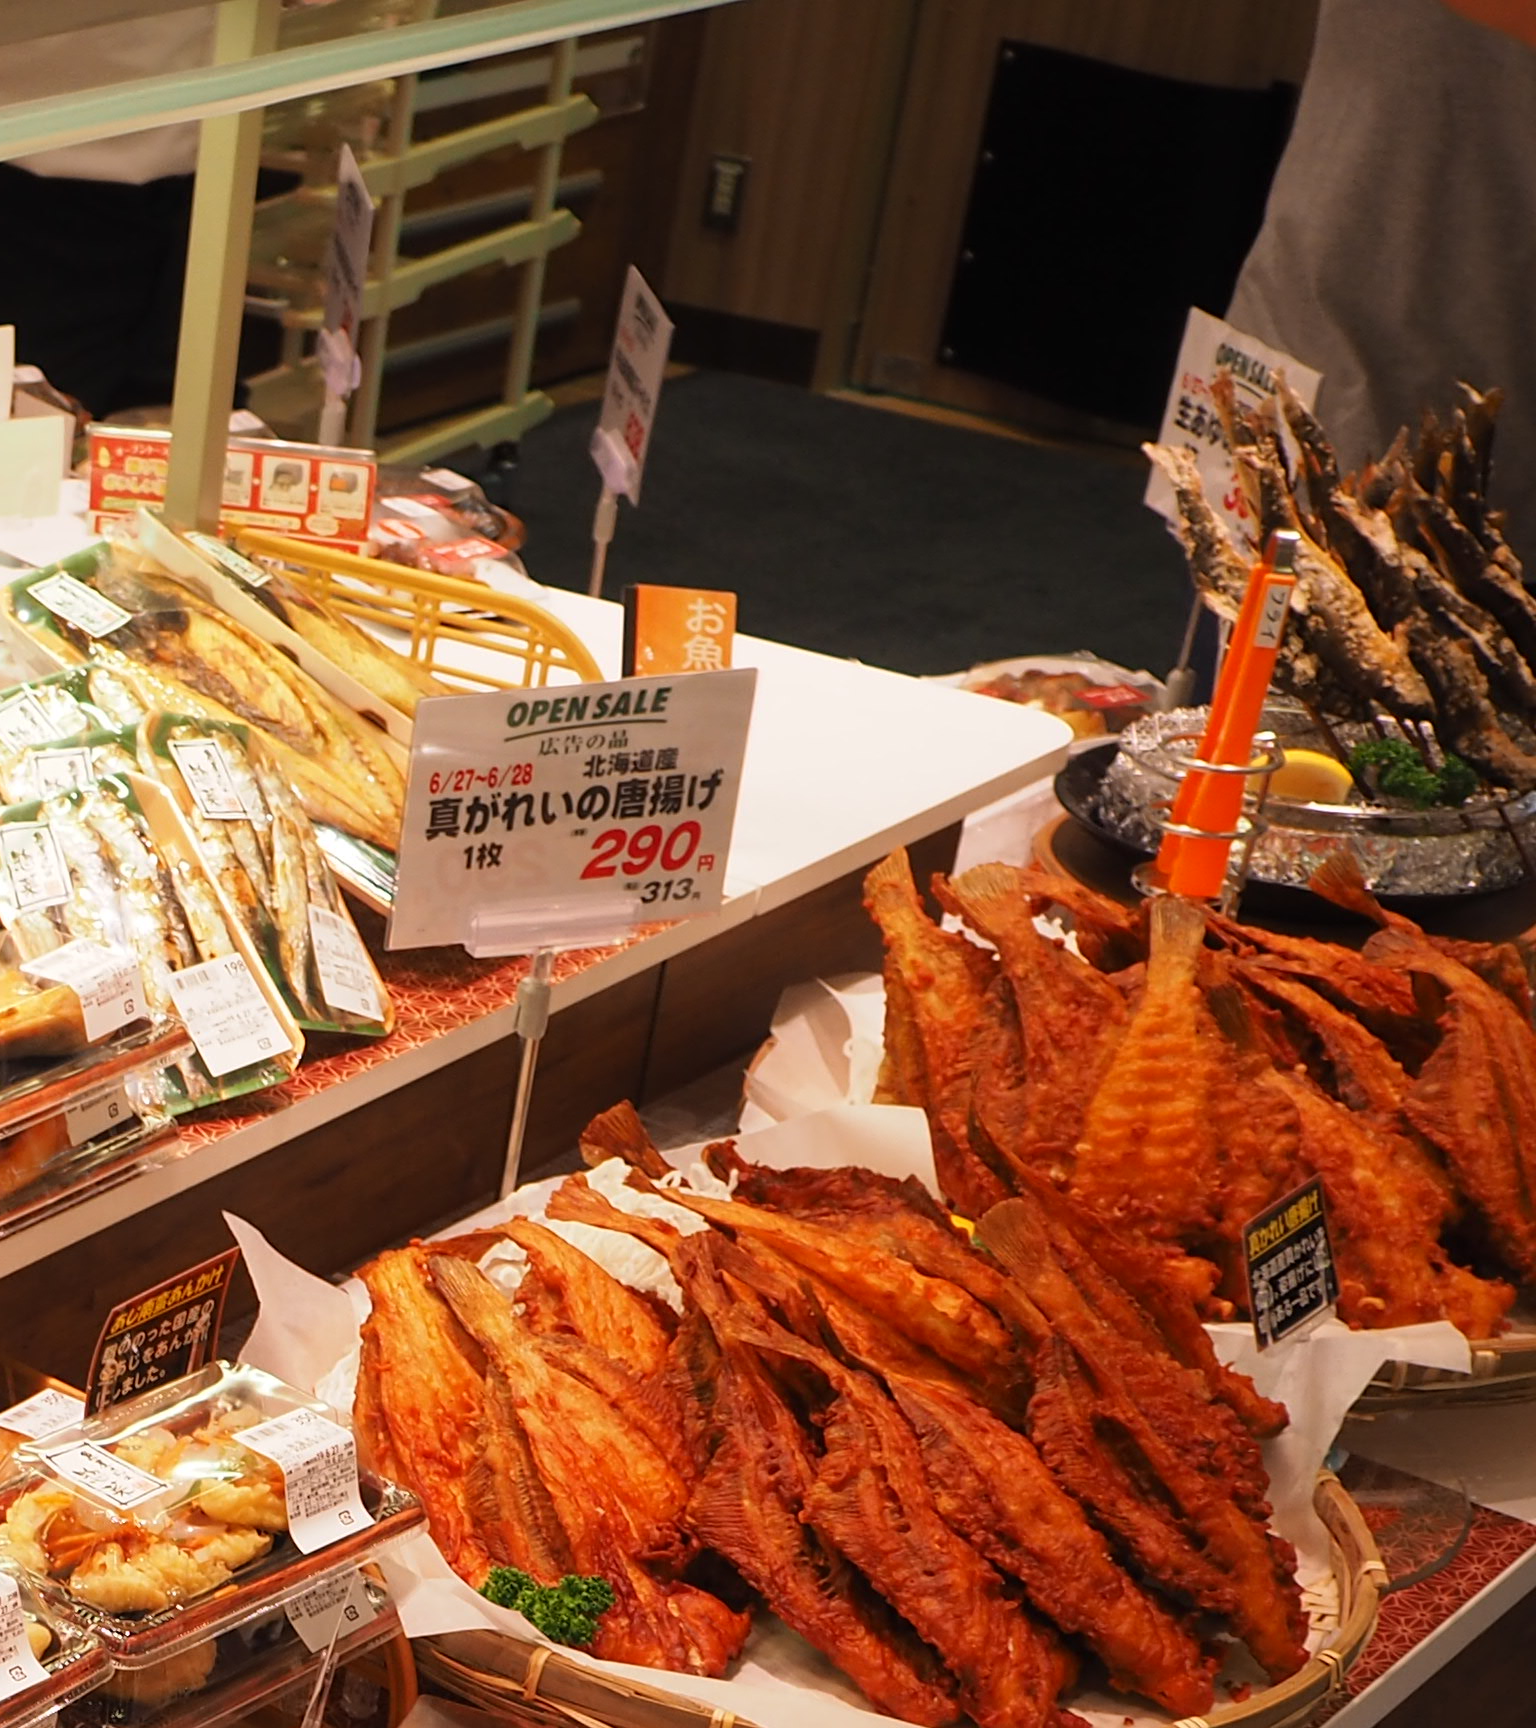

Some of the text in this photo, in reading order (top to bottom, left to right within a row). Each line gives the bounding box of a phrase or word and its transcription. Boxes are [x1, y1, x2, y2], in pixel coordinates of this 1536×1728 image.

[506, 686, 672, 729] OPEN SALE
[538, 730, 630, 757] 広告の品
[583, 747, 680, 779] 北海道産
[425, 768, 724, 841] 真がれいの唐揚げ
[464, 842, 504, 871] 1枚
